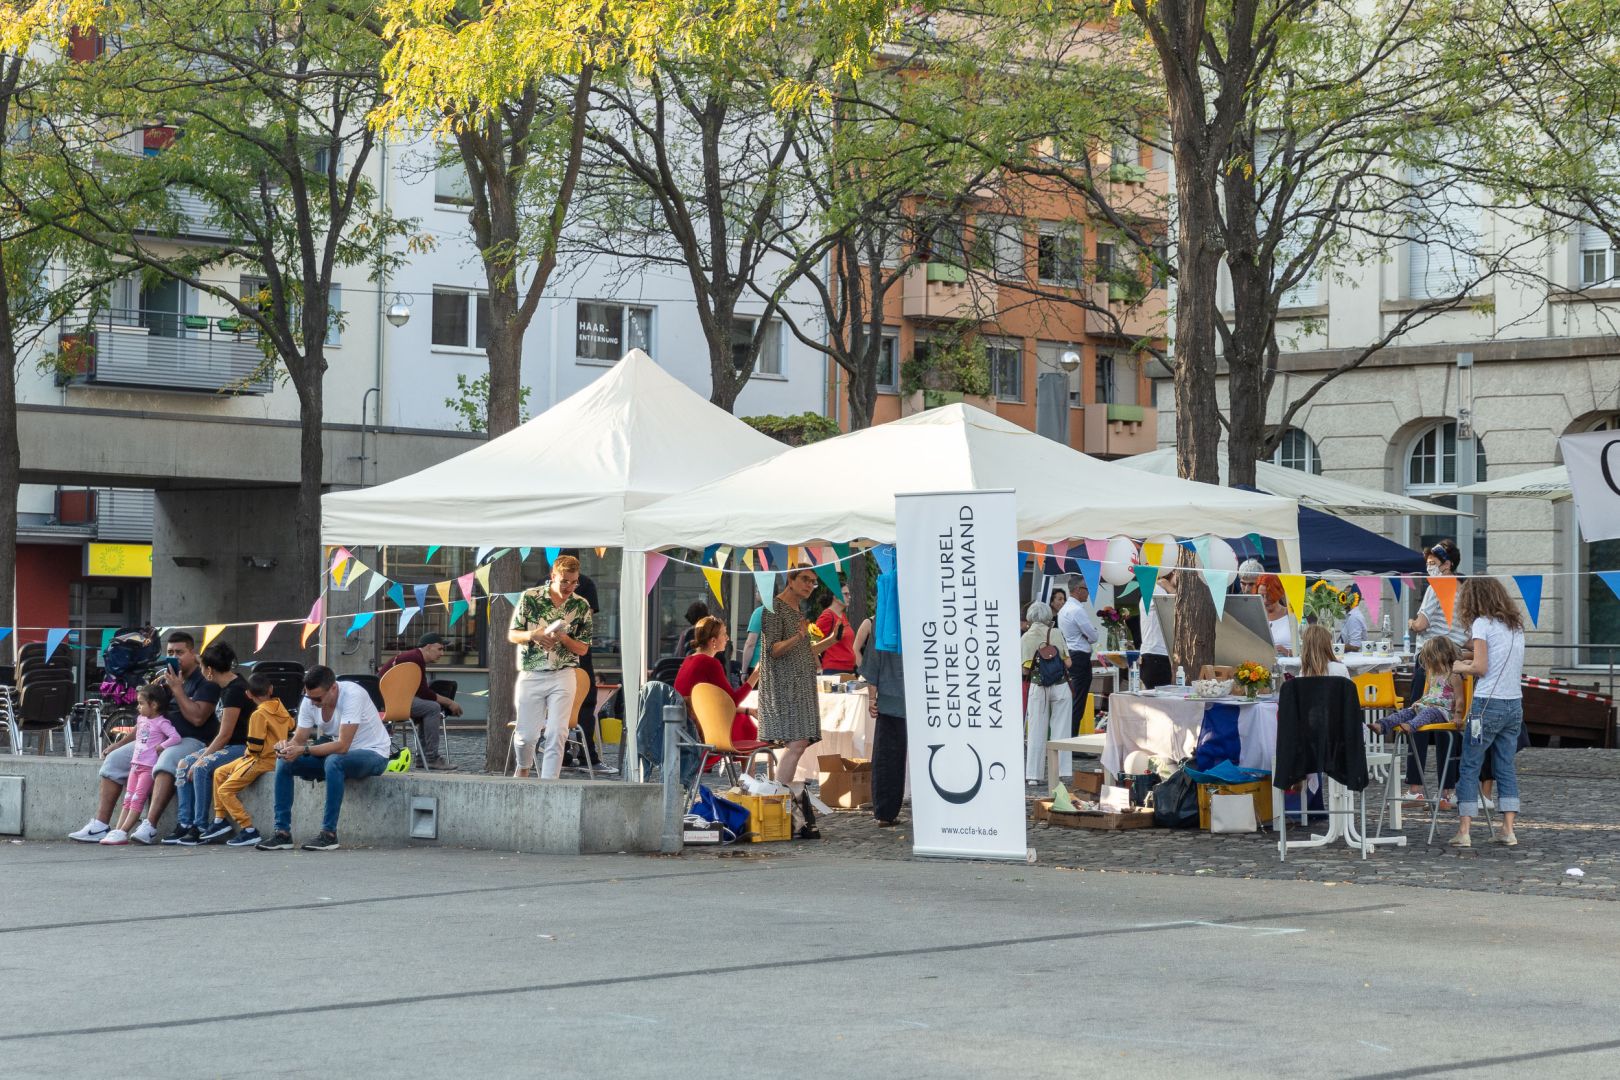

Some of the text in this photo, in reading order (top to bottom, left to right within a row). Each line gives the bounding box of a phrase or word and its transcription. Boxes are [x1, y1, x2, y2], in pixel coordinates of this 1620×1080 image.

[579, 321, 610, 333] HAAR-
[579, 333, 619, 345] ENTFERNUNG
[939, 526, 961, 728] CENTRE CULTUREL
[959, 505, 982, 728] FRANCO-ALLEMAND
[985, 599, 1003, 729] KARLSRUHE
[922, 621, 941, 728] STIFTUNG
[941, 826, 998, 836] www.ccfa-ka.de
